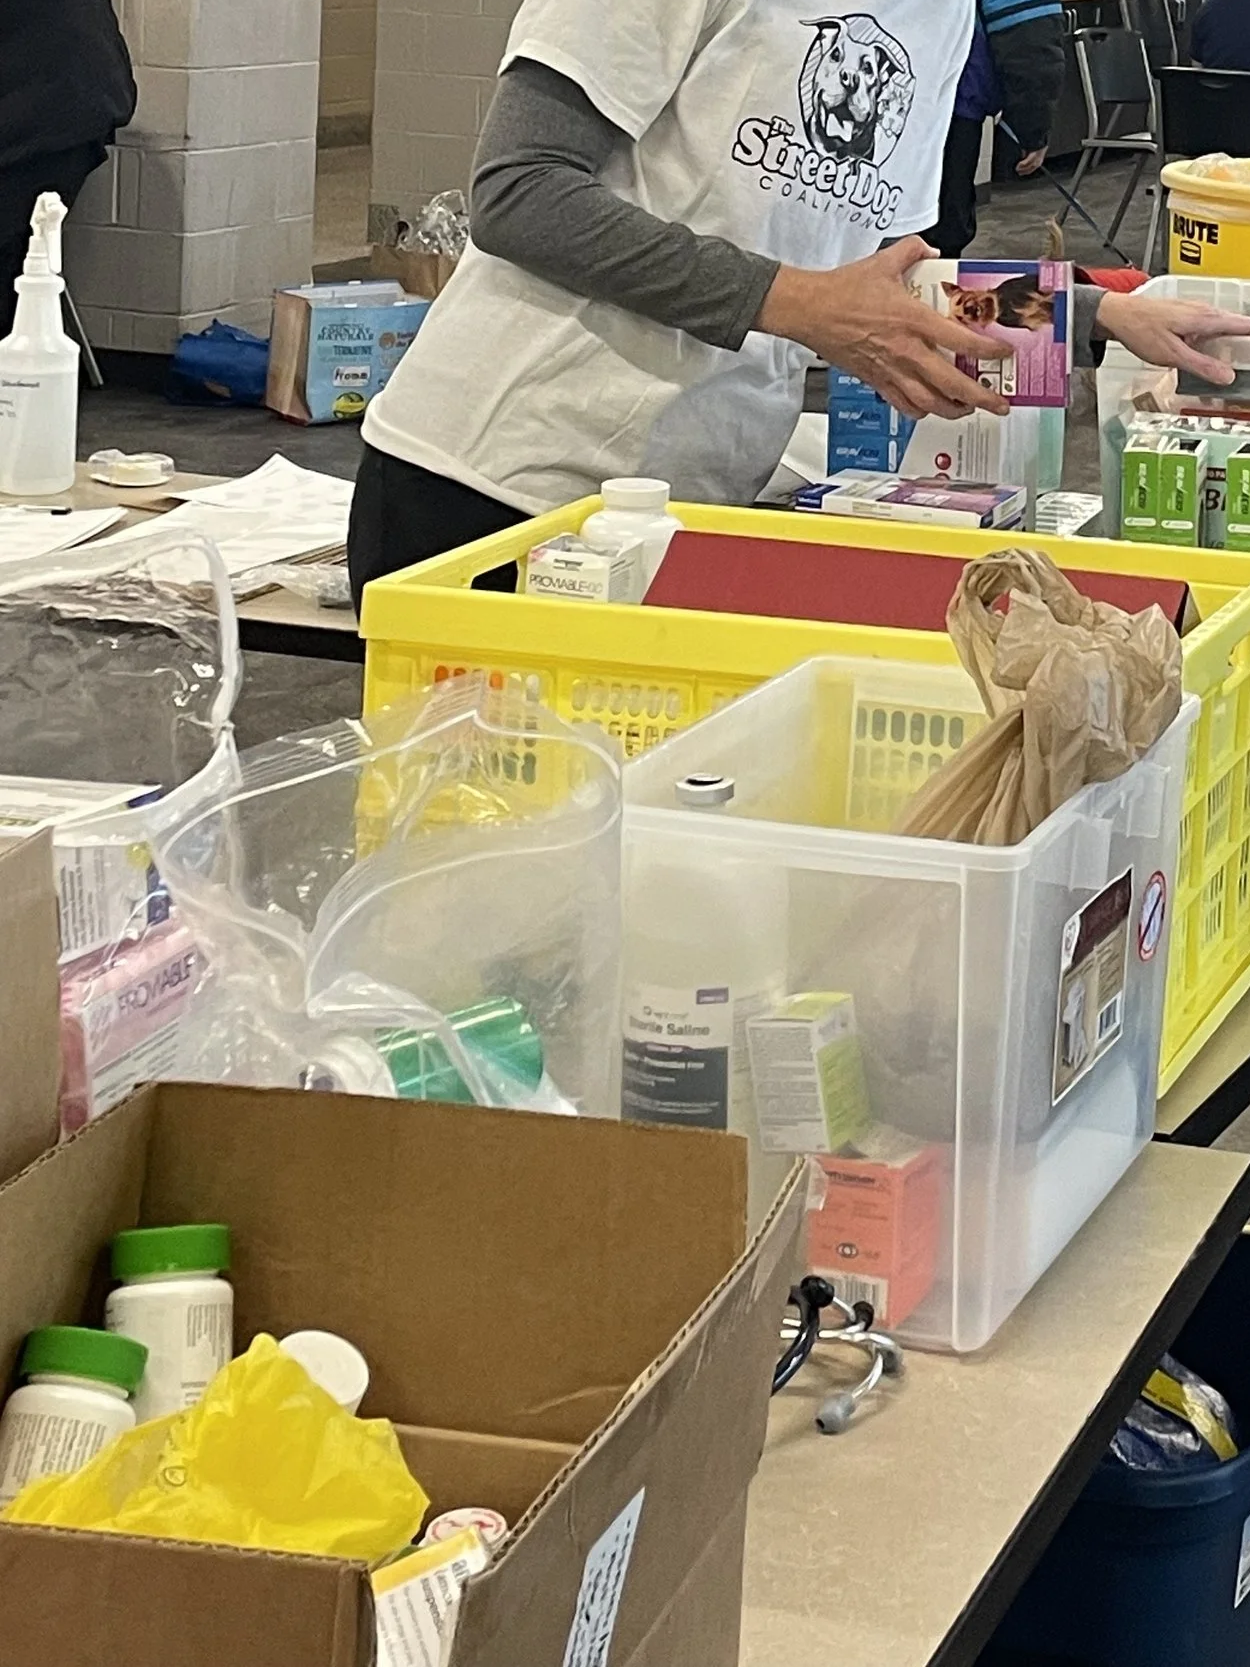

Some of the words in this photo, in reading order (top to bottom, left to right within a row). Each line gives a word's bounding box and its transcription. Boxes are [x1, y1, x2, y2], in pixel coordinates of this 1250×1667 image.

[732, 118, 853, 198] Street
[849, 159, 904, 230] Dog
[759, 175, 876, 230] COALITION
[1173, 213, 1219, 245] BRUTE
